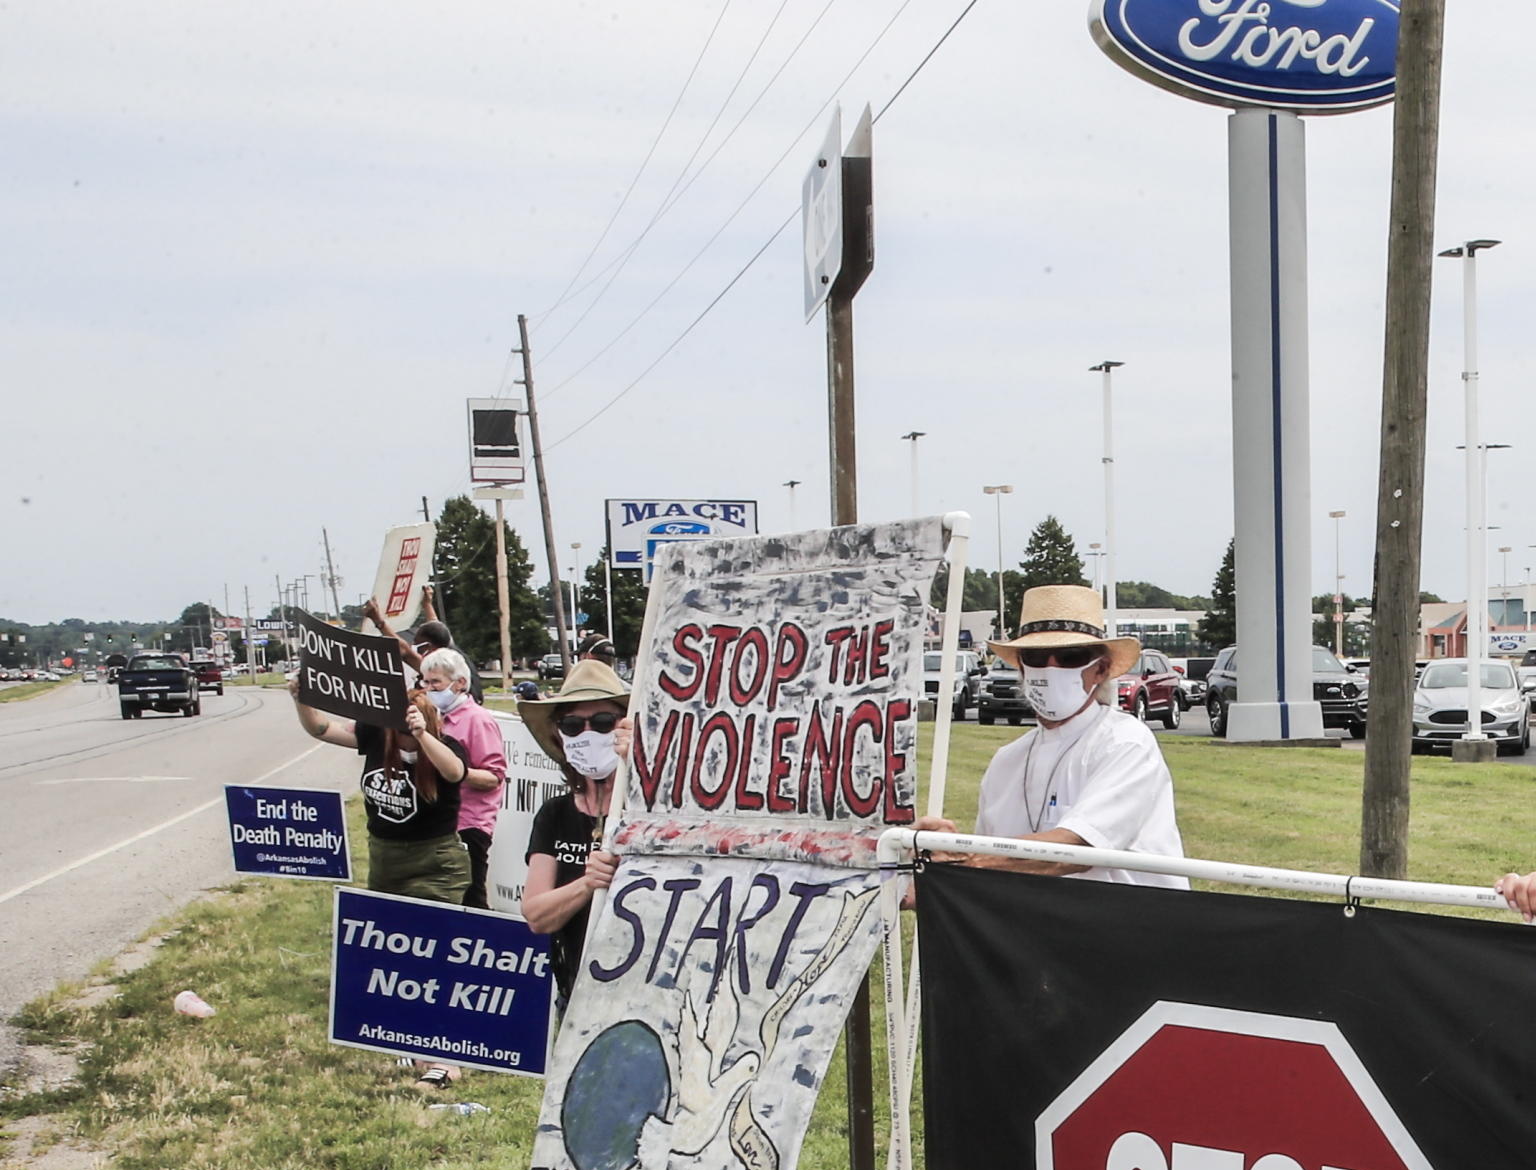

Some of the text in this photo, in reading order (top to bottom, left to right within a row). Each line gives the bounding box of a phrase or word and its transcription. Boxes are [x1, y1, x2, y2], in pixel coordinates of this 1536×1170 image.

[1178, 0, 1374, 77] Ford
[622, 503, 745, 528] MACE
[299, 623, 402, 676] DON'T KILL
[1490, 635, 1526, 643] MACE
[657, 619, 895, 712] STOP THE
[307, 666, 390, 711] FOR ME!
[633, 698, 916, 826] VIOLENCE
[256, 799, 318, 821] End the
[516, 778, 538, 814] NOT
[233, 824, 343, 855] Death Penalty
[256, 853, 327, 865] @ArkansasAbolish
[342, 918, 550, 978] Thou Shalt
[589, 873, 832, 995] START
[367, 968, 516, 1016] Not Kill
[358, 1023, 521, 1066] ArkansasAbolish.org
